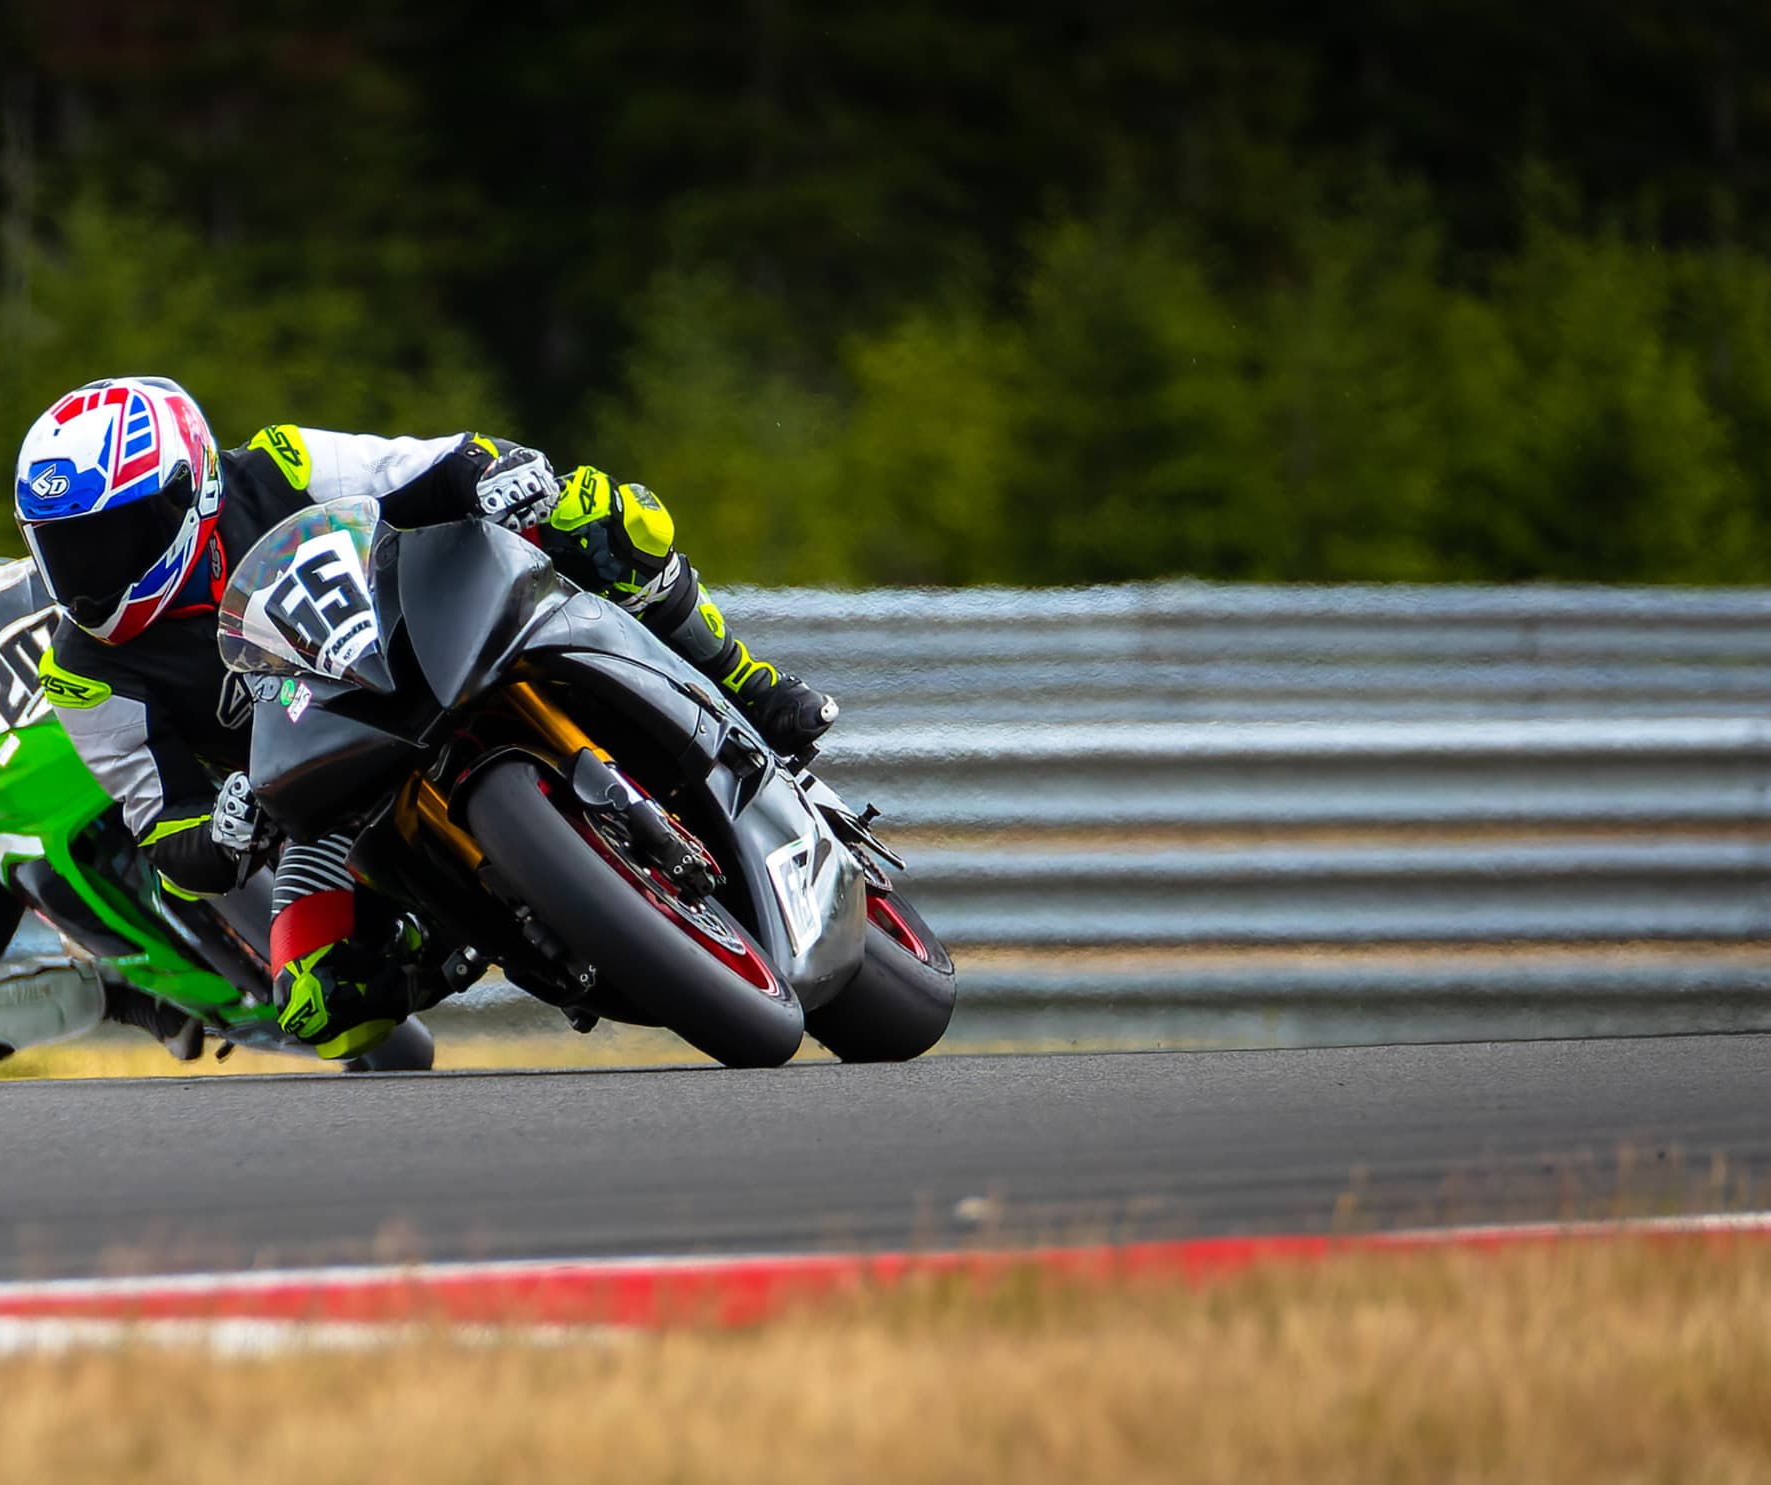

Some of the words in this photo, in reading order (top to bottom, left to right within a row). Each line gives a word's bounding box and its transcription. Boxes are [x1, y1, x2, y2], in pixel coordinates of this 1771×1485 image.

[264, 426, 303, 467] 4S
[263, 549, 371, 671] 65
[40, 674, 90, 701] SR
